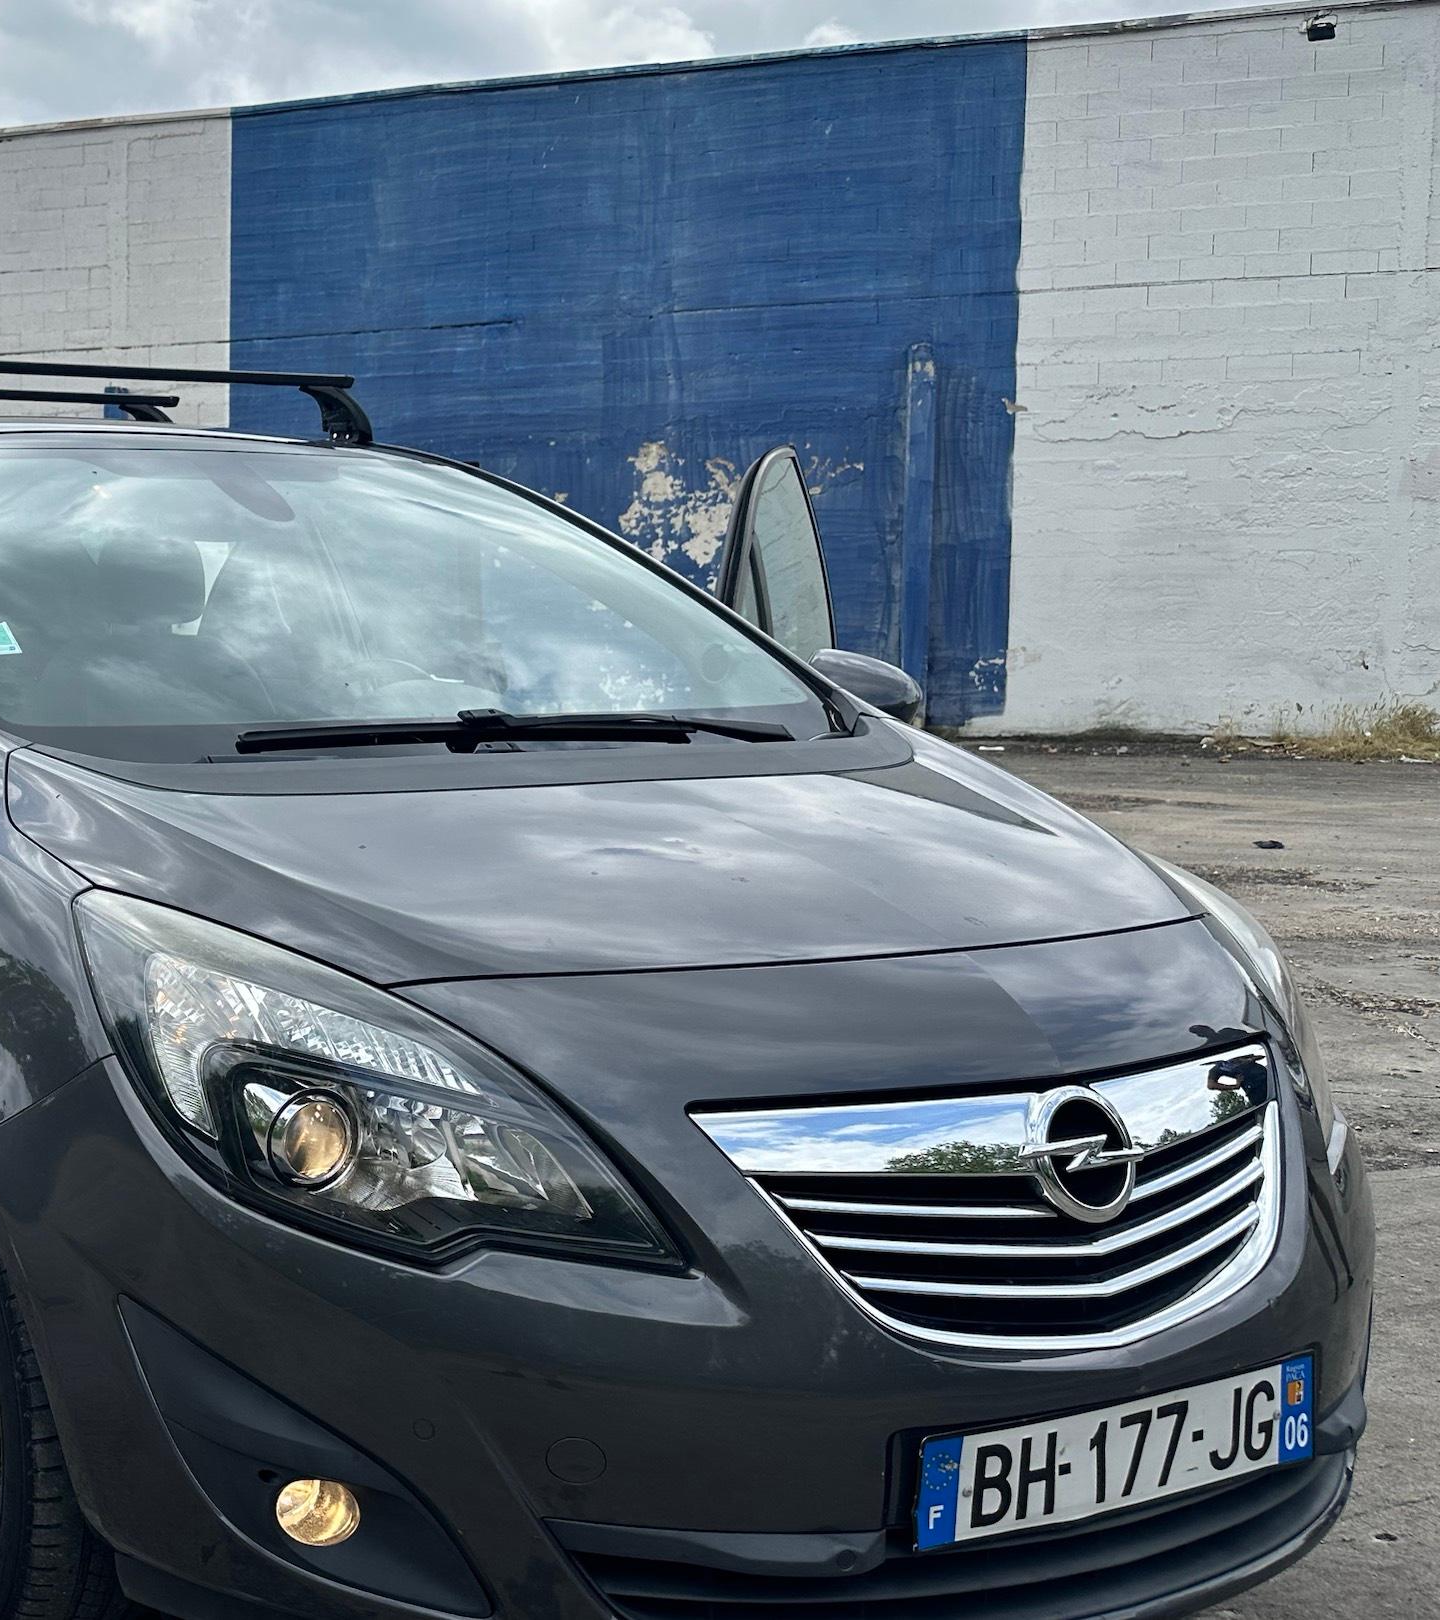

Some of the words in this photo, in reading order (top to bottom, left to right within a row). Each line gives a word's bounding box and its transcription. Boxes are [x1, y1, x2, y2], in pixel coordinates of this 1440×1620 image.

[1285, 1413, 1308, 1450] 06
[970, 1380, 1275, 1528] BH-177-JG
[928, 1504, 944, 1530] F
